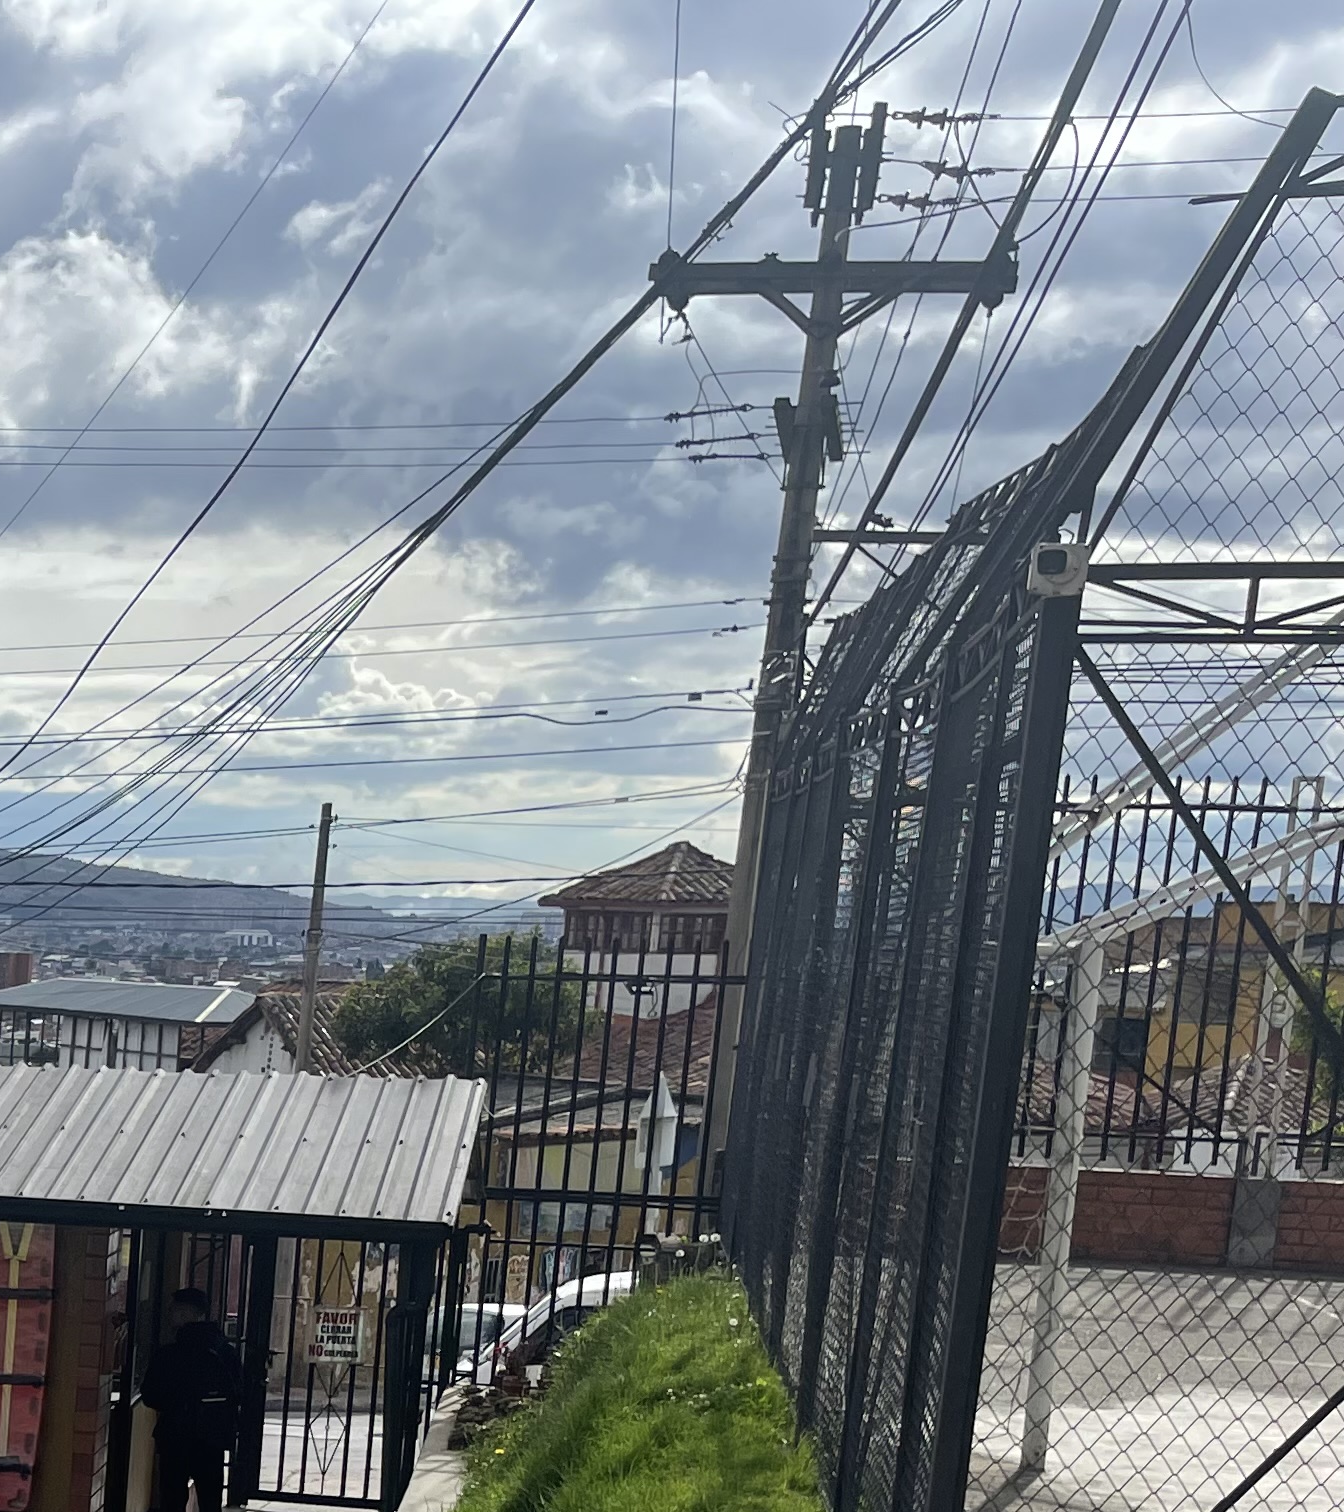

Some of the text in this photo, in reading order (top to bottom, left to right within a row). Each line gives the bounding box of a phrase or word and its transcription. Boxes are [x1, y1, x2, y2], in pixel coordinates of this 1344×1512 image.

[315, 1312, 357, 1324] FAVOR
[315, 1335, 357, 1345] LA PUERTA
[308, 1343, 324, 1357] NO
